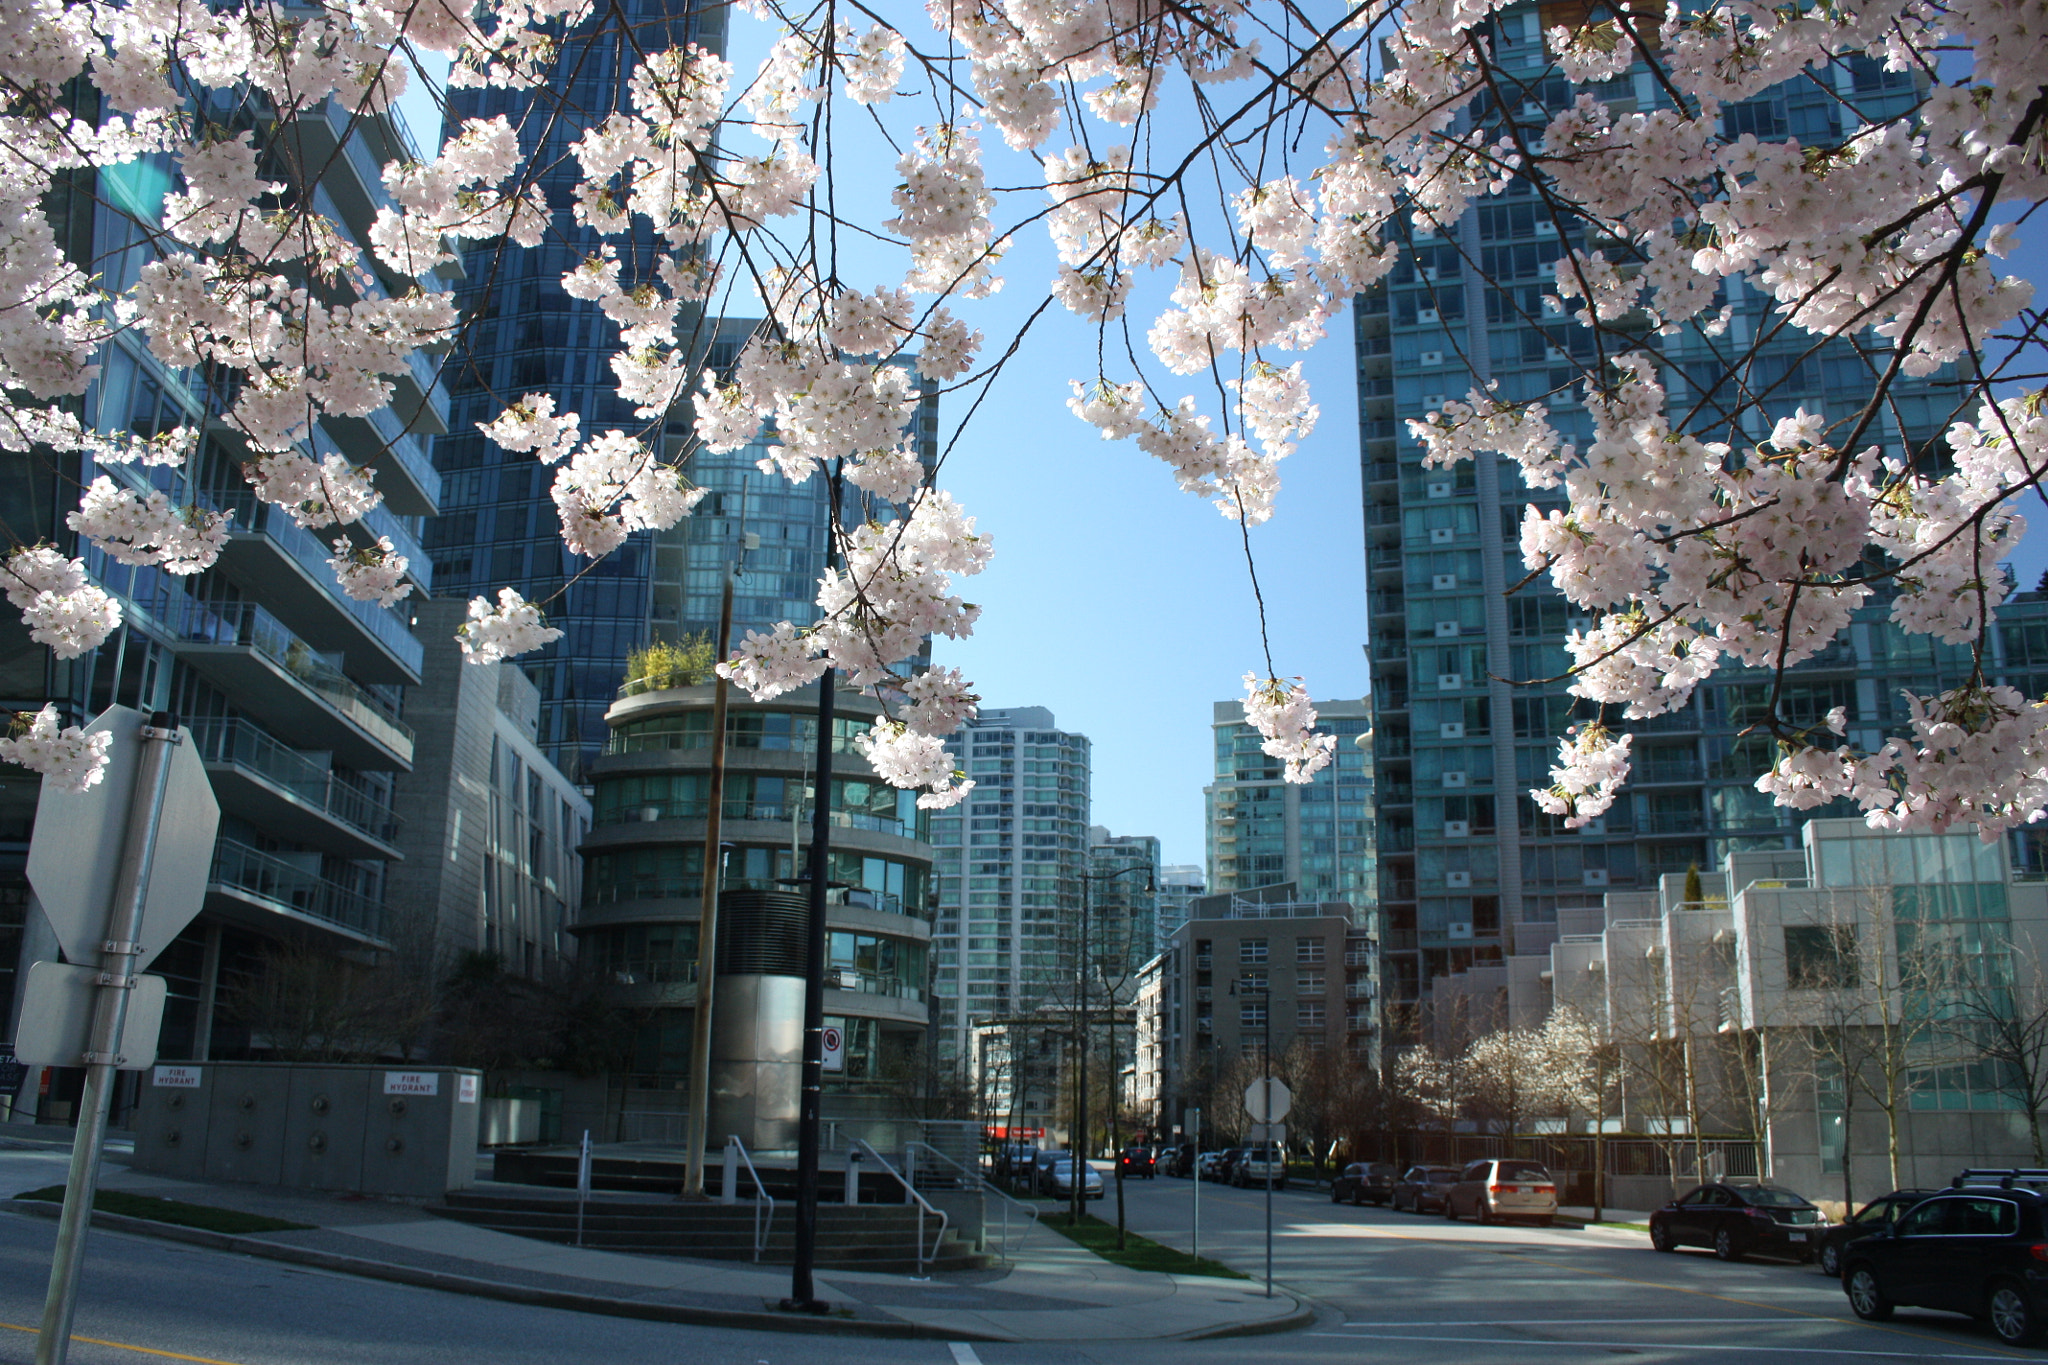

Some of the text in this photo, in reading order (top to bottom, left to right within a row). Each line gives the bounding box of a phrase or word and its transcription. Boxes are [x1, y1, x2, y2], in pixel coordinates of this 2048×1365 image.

[158, 1076, 195, 1084] HYDRANT
[401, 1075, 420, 1083] FIRE
[390, 1083, 431, 1091] HYDRANT
